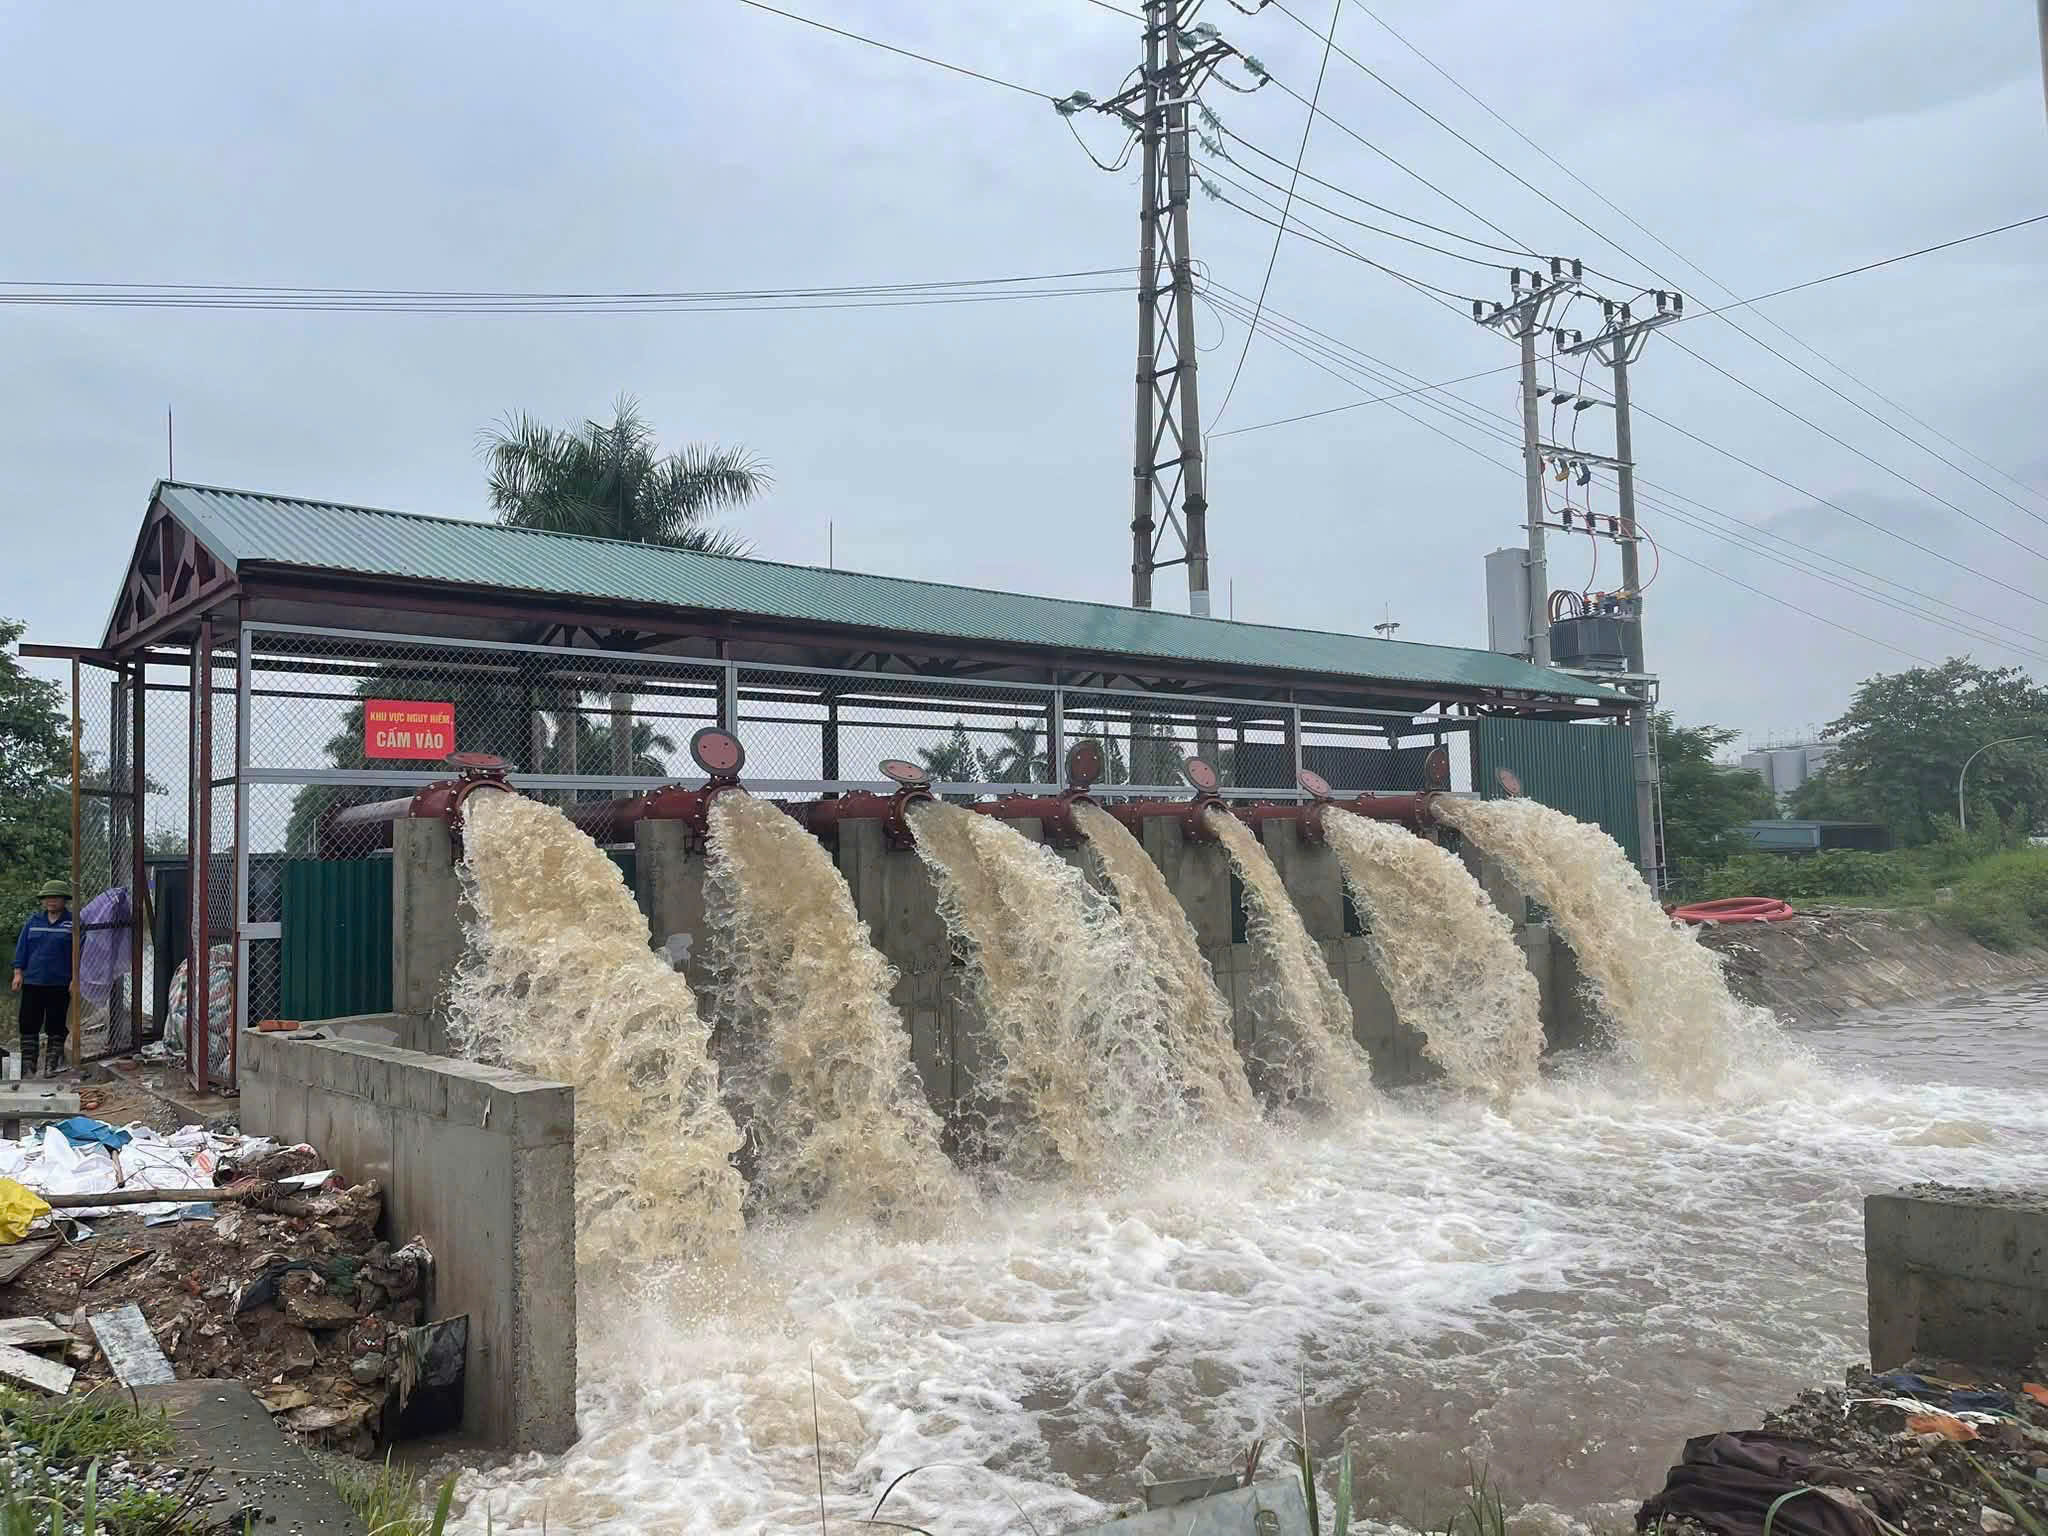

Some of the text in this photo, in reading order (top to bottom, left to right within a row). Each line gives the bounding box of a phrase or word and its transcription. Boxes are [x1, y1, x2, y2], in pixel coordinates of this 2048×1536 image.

[370, 711, 387, 721] KHU
[389, 712, 405, 723] VỰC
[406, 713, 428, 723] NGUY
[376, 727, 444, 749] CẤM VÀO
